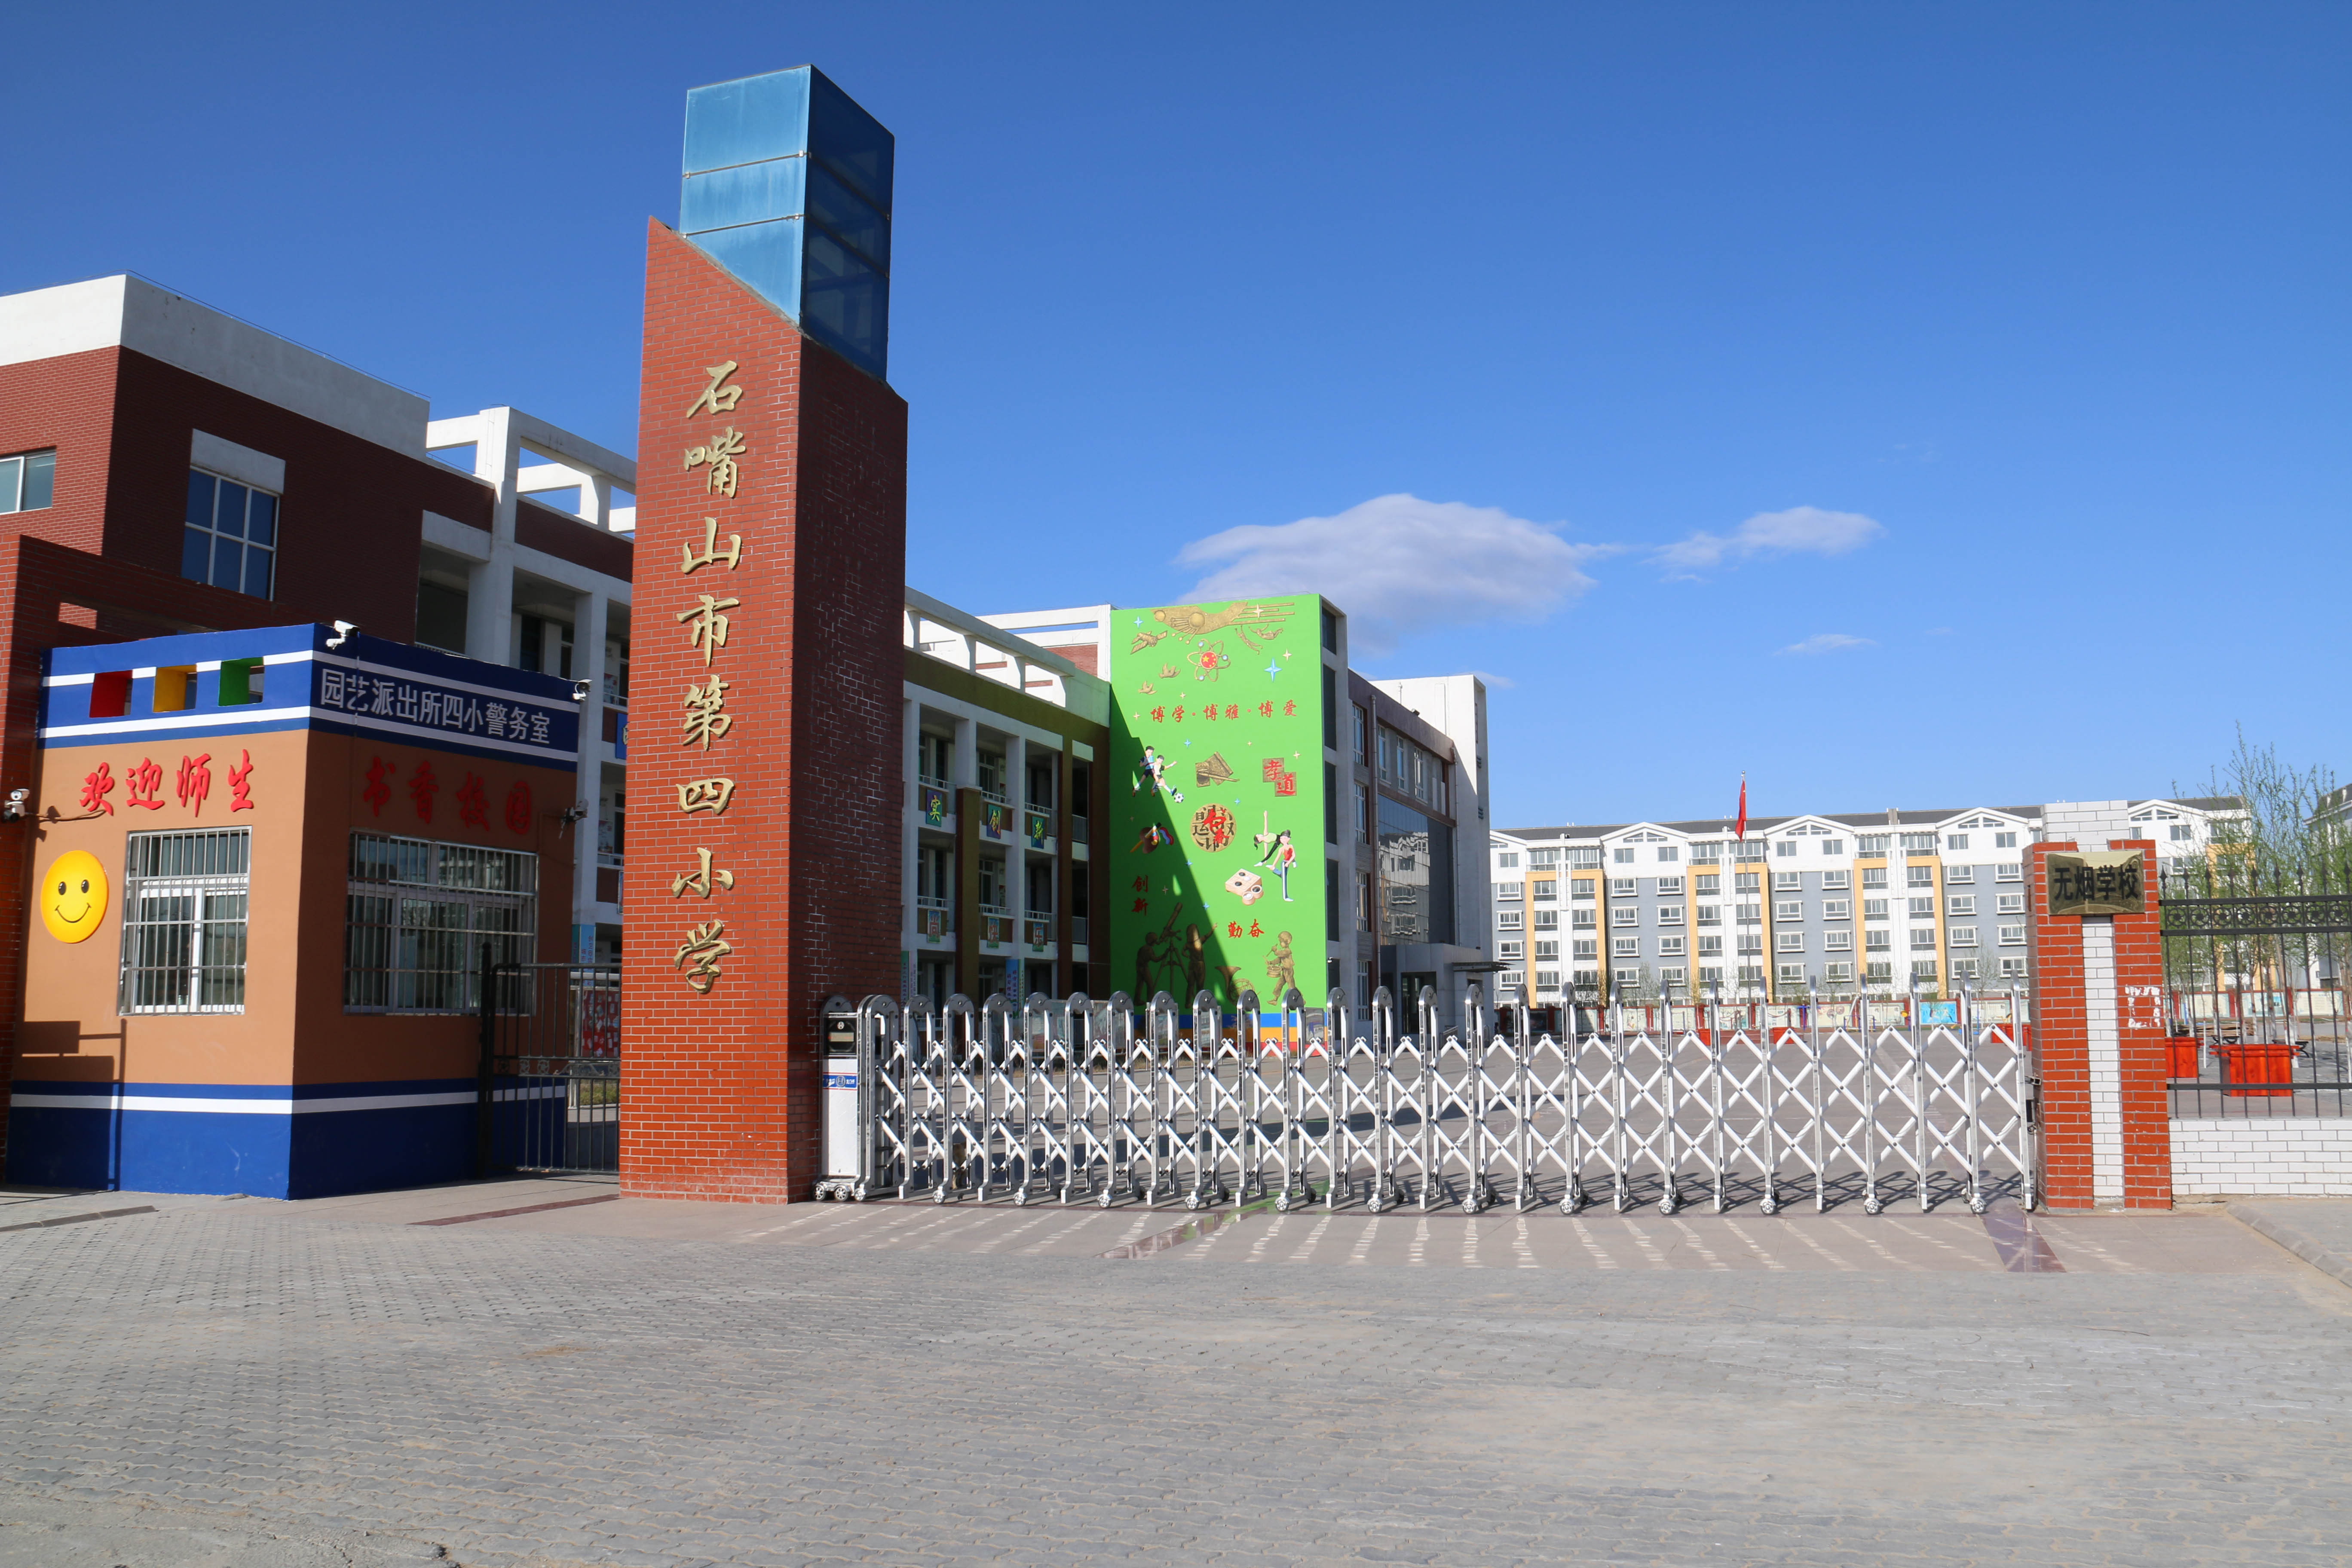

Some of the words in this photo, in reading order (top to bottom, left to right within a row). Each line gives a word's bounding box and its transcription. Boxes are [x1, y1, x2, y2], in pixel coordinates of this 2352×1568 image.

[671, 360, 746, 994] 石嘴山市第四小学
[320, 668, 550, 744] 园艺派出所四小警务室
[79, 749, 255, 817] 欢迎师生
[362, 756, 532, 834] 书香校园
[1264, 760, 1296, 796] 孝道
[1131, 875, 1149, 916] 创新
[2053, 864, 2140, 902] 无烟学校
[1227, 918, 1265, 939] 勤奋
